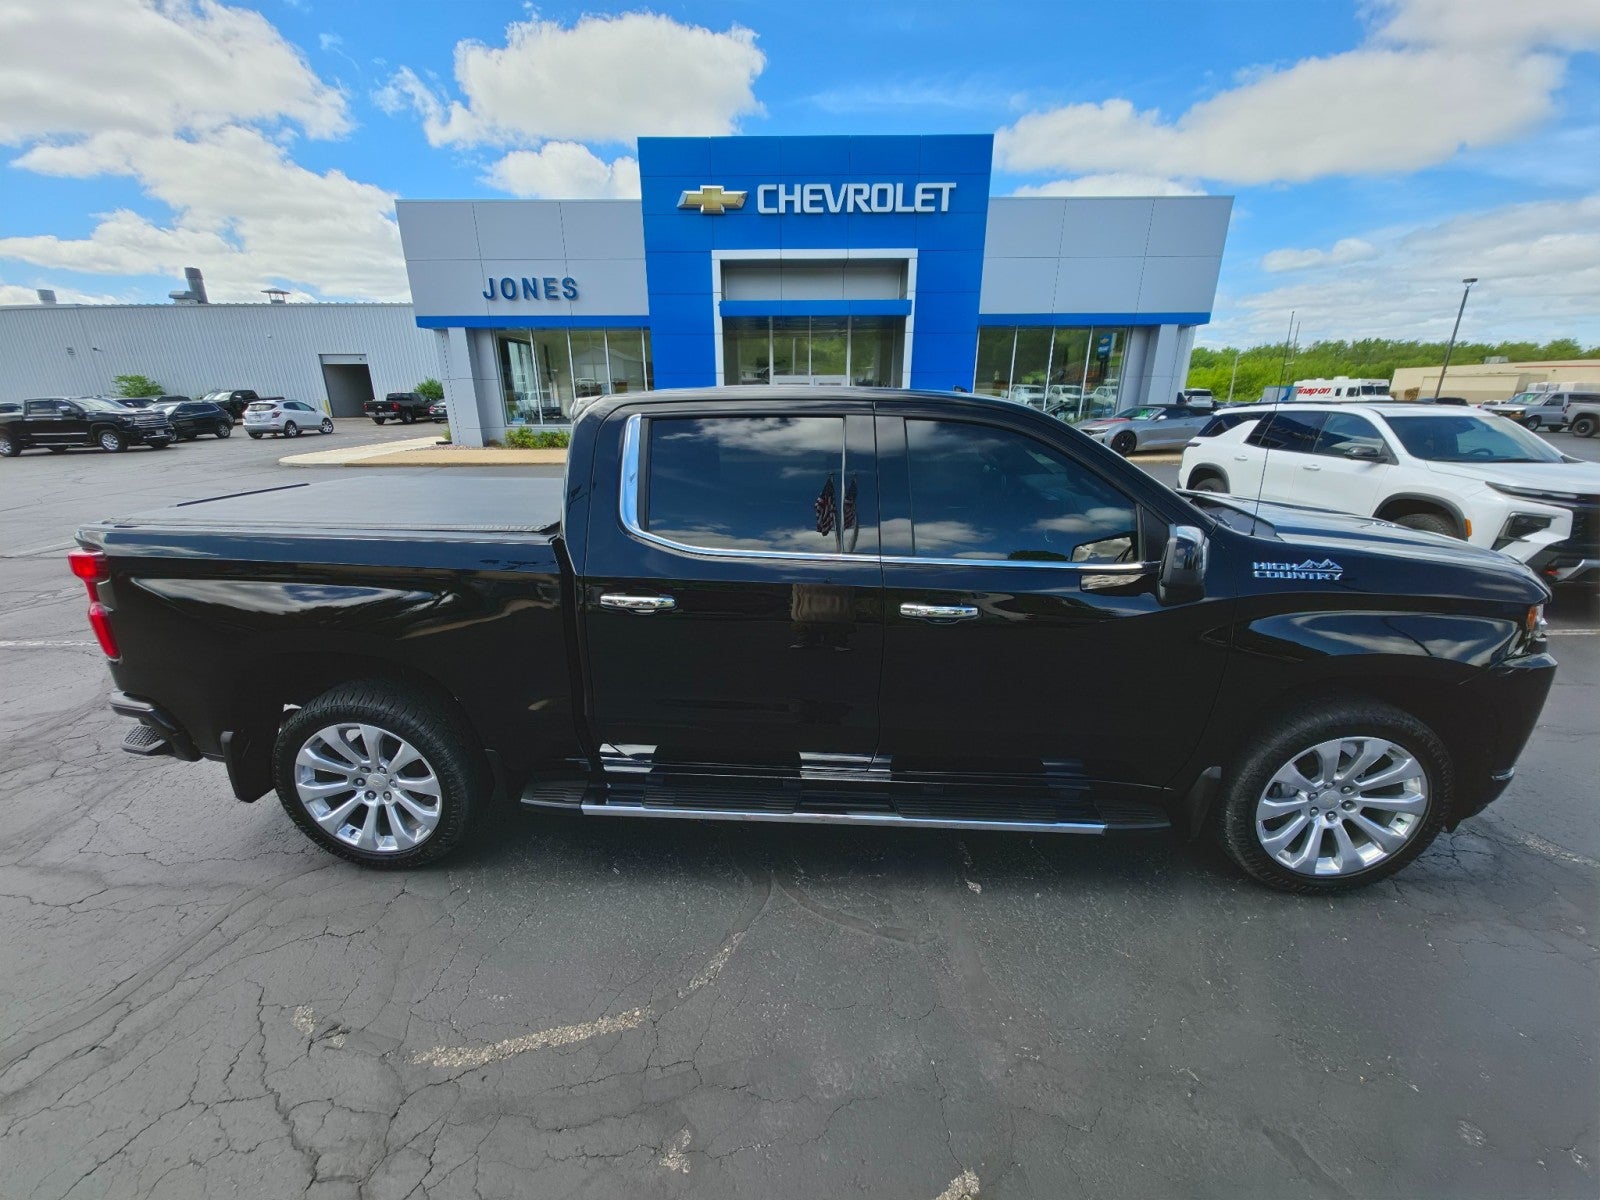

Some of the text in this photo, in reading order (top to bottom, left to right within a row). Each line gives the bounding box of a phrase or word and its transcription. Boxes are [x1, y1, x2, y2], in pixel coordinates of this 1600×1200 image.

[757, 183, 957, 214] CHEVROLET
[482, 277, 579, 300] JONES
[1253, 562, 1299, 571] HIGH
[1253, 571, 1342, 580] COUNTRY
